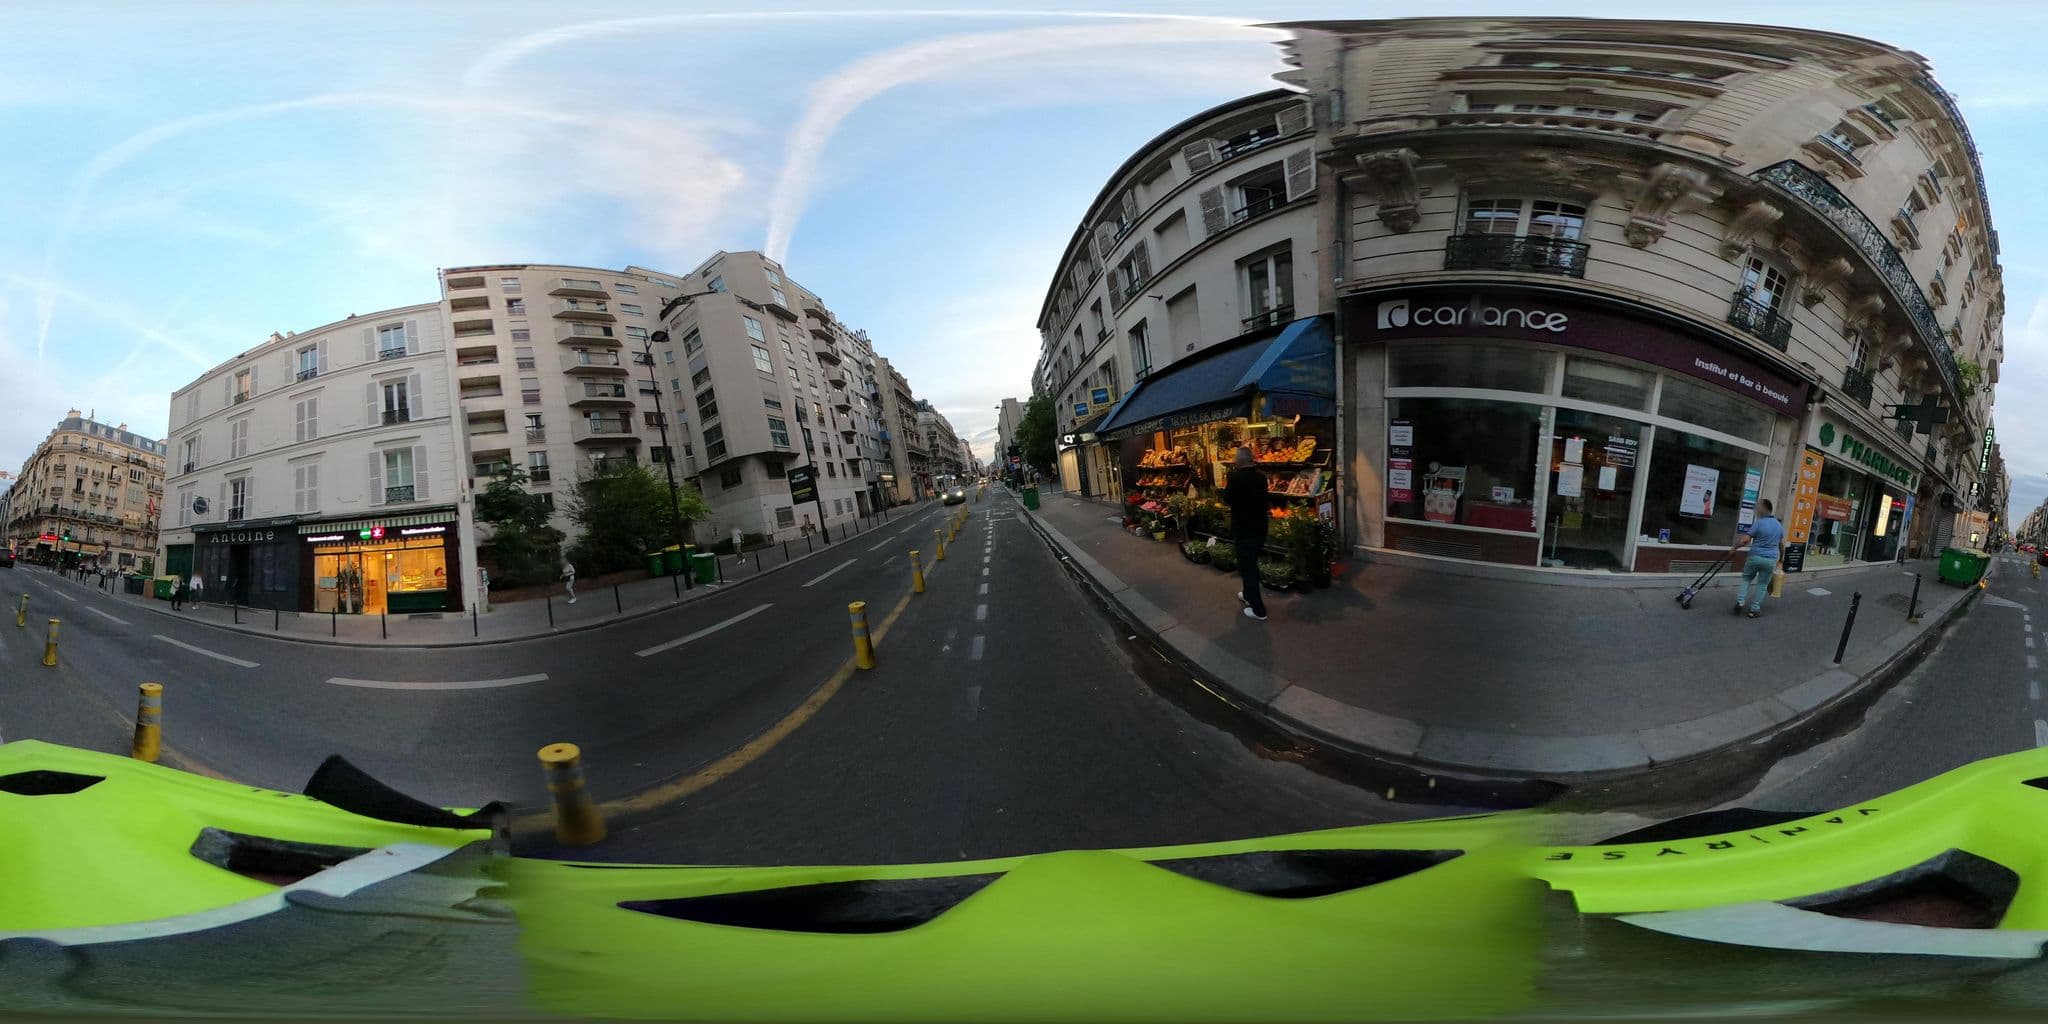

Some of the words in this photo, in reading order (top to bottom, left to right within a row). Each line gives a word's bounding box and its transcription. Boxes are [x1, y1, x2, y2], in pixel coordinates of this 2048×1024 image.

[1695, 357, 1728, 376] Institut
[1728, 372, 1739, 383] et
[1739, 375, 1754, 389] Bar
[1754, 381, 1762, 392] à
[1762, 384, 1789, 405] beauté
[1840, 433, 1912, 487] PHARMACIE
[1982, 428, 1994, 462] HOTEL
[211, 529, 275, 544] Antoine
